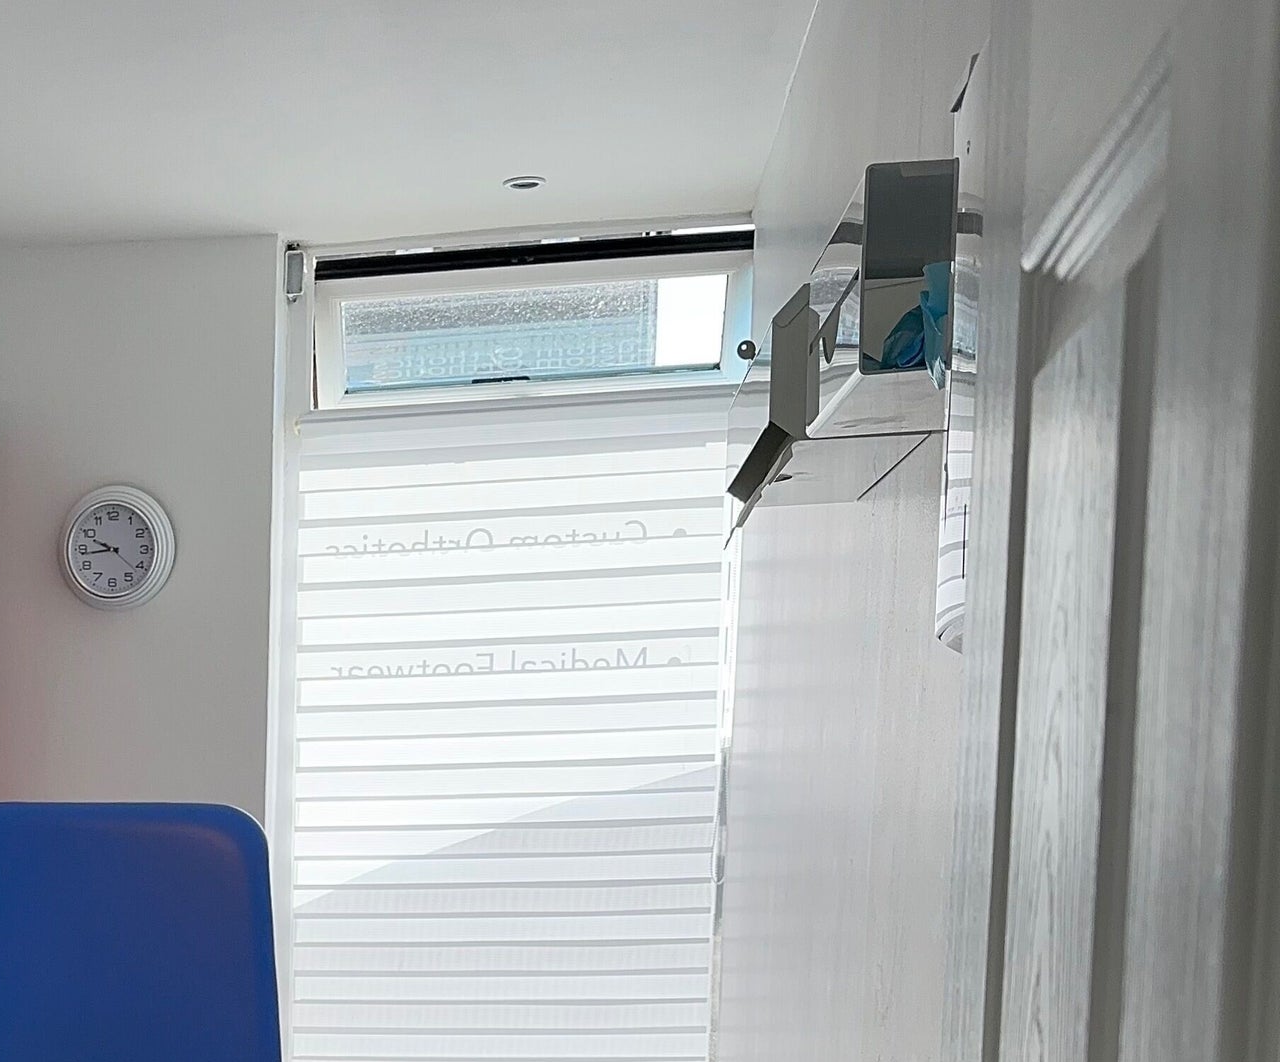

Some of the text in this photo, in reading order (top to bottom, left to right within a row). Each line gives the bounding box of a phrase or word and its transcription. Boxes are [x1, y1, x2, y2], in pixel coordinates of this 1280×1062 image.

[94, 516, 102, 526] 11
[106, 511, 120, 521] 12
[127, 516, 132, 525] 1
[82, 528, 96, 539] 10
[135, 528, 145, 538] 2
[78, 544, 88, 554] 9
[140, 545, 149, 554] 3
[82, 561, 92, 570] 8
[135, 561, 144, 569] 4
[93, 572, 103, 582] 7
[124, 572, 133, 582] 5
[107, 578, 117, 587] 6
